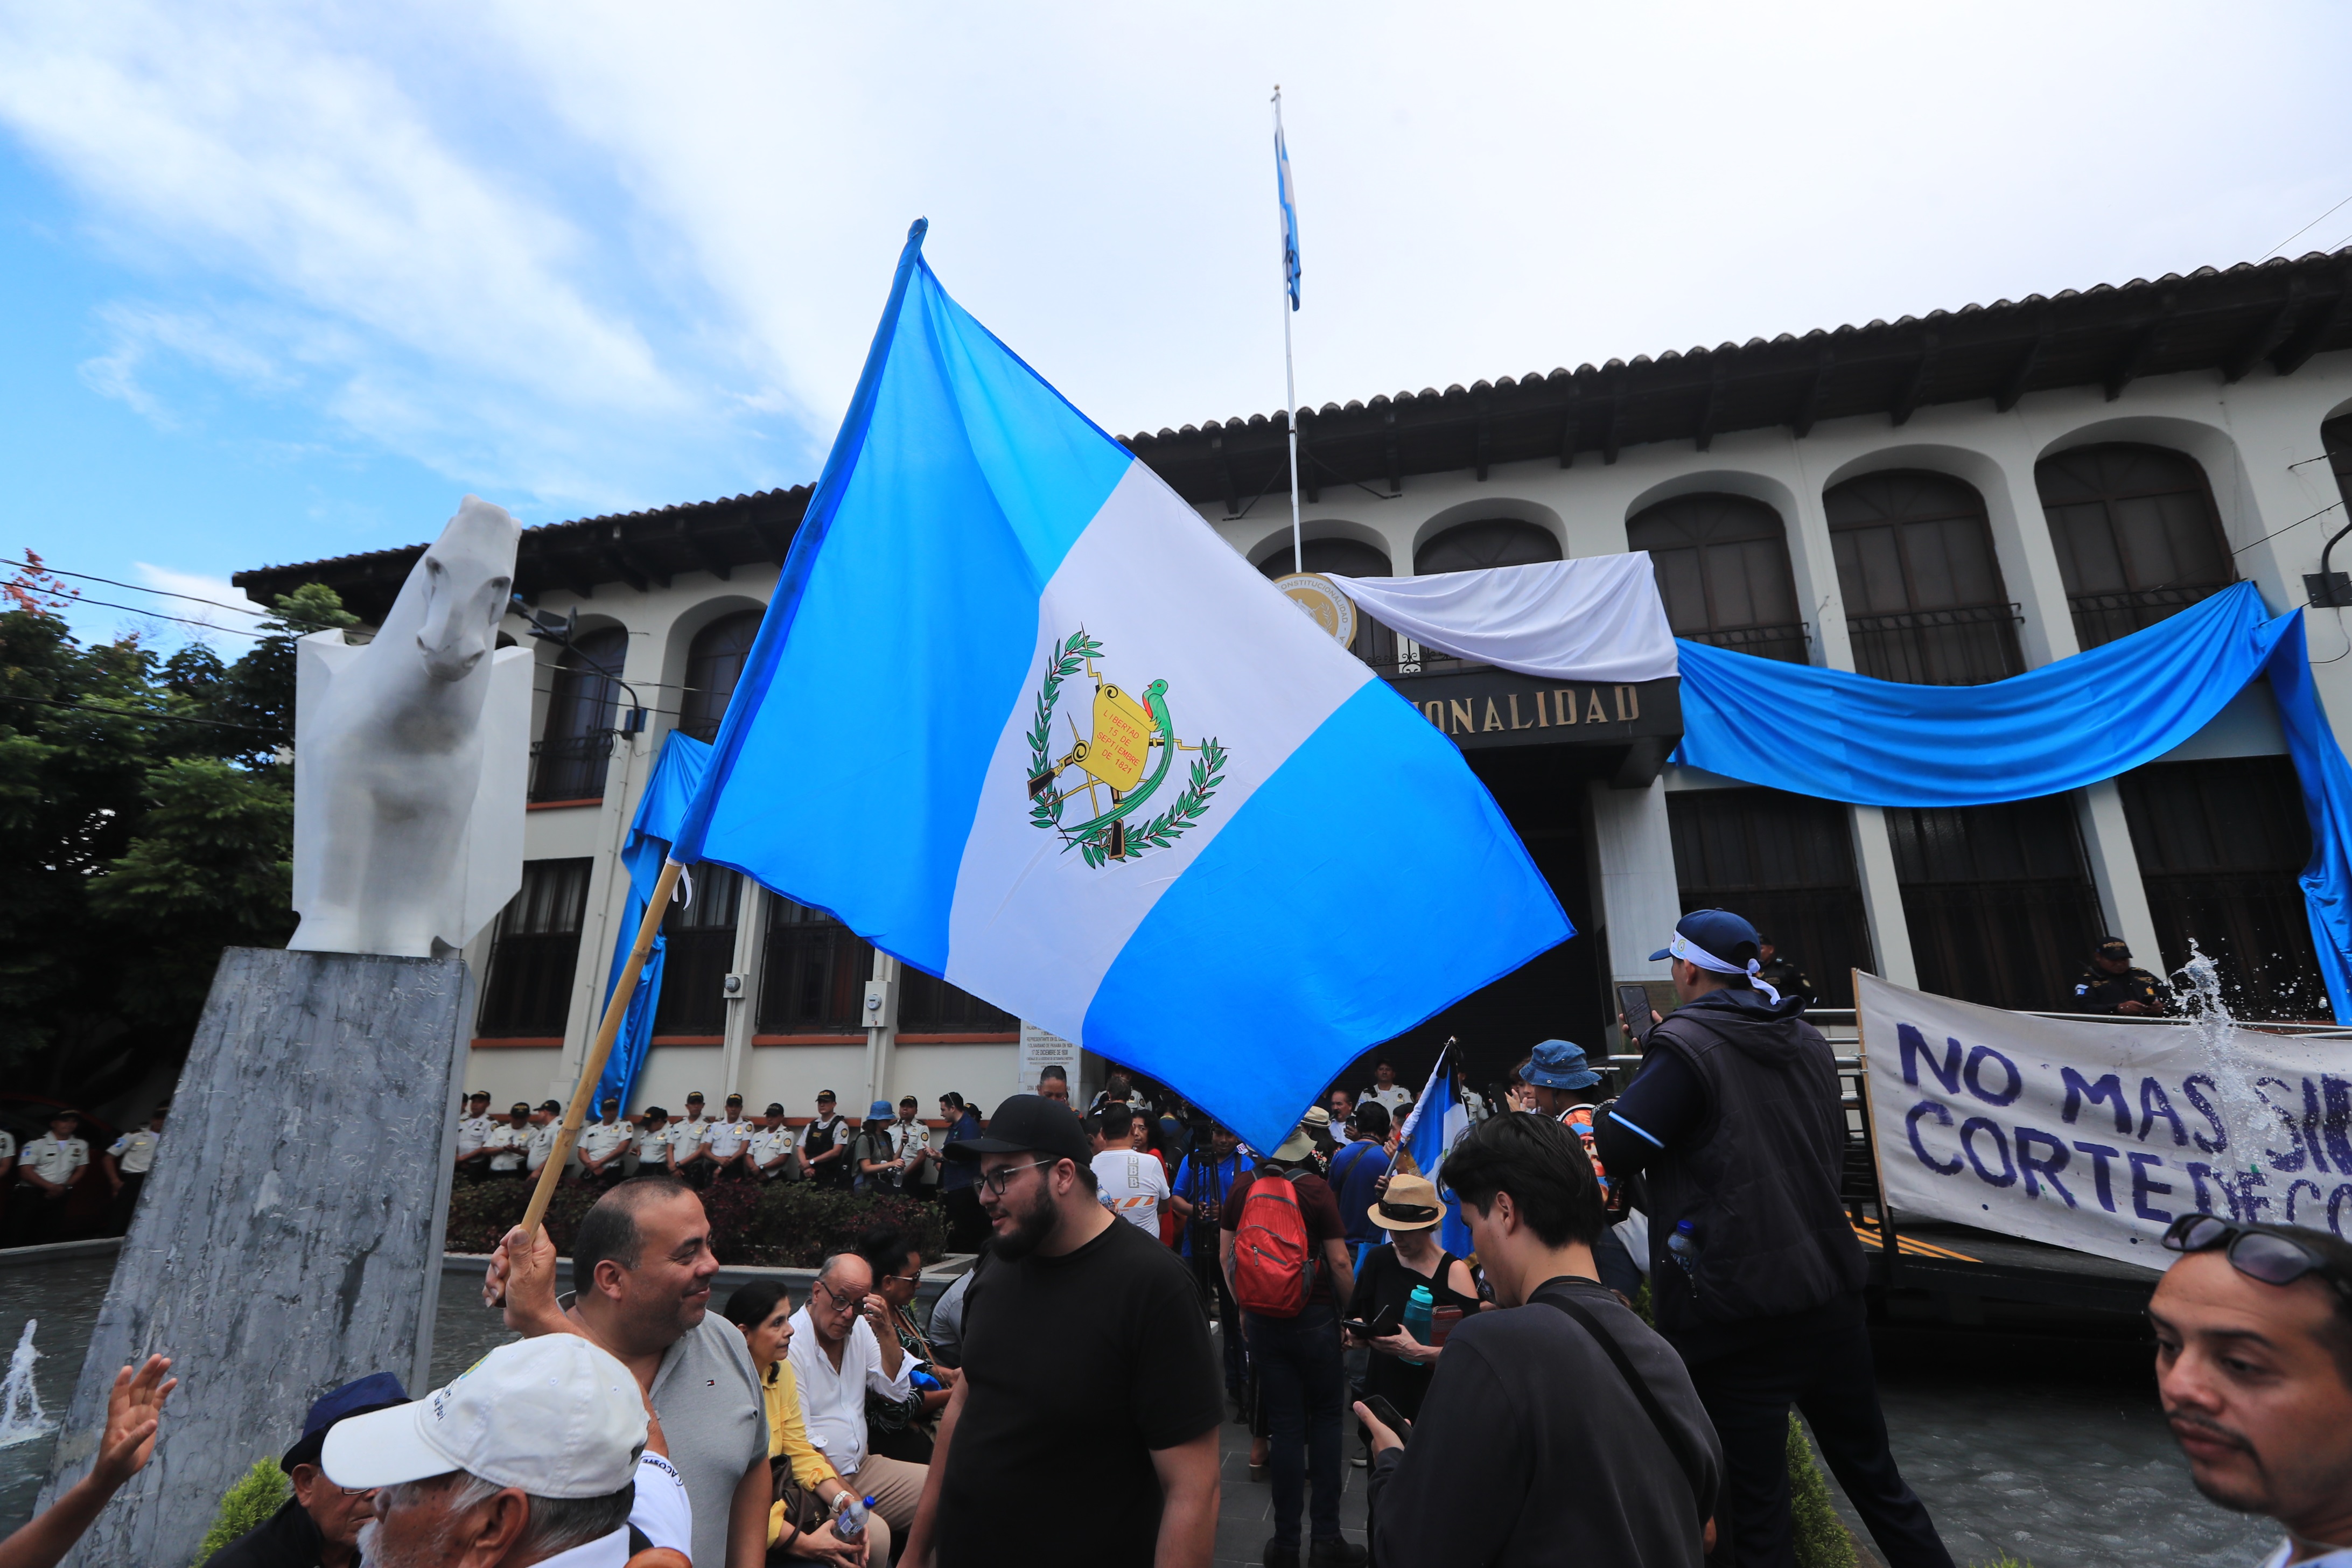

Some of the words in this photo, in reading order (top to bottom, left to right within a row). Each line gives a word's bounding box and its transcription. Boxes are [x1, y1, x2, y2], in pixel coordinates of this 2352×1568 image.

[1280, 579, 1348, 624] ONSTITUCIONALIDAD
[1103, 709, 1139, 739] LIBERTAD
[1412, 684, 1640, 735] ONALIDAD
[1097, 732, 1140, 767] SEPTIEMBRE
[1109, 727, 1118, 737] 15
[1120, 735, 1131, 747] DE
[1102, 749, 1112, 760] DE
[1115, 759, 1132, 774] 1821
[1896, 1023, 2022, 1107] NO
[2060, 1066, 2229, 1154] MAS
[1905, 1101, 2173, 1224] CORTE
